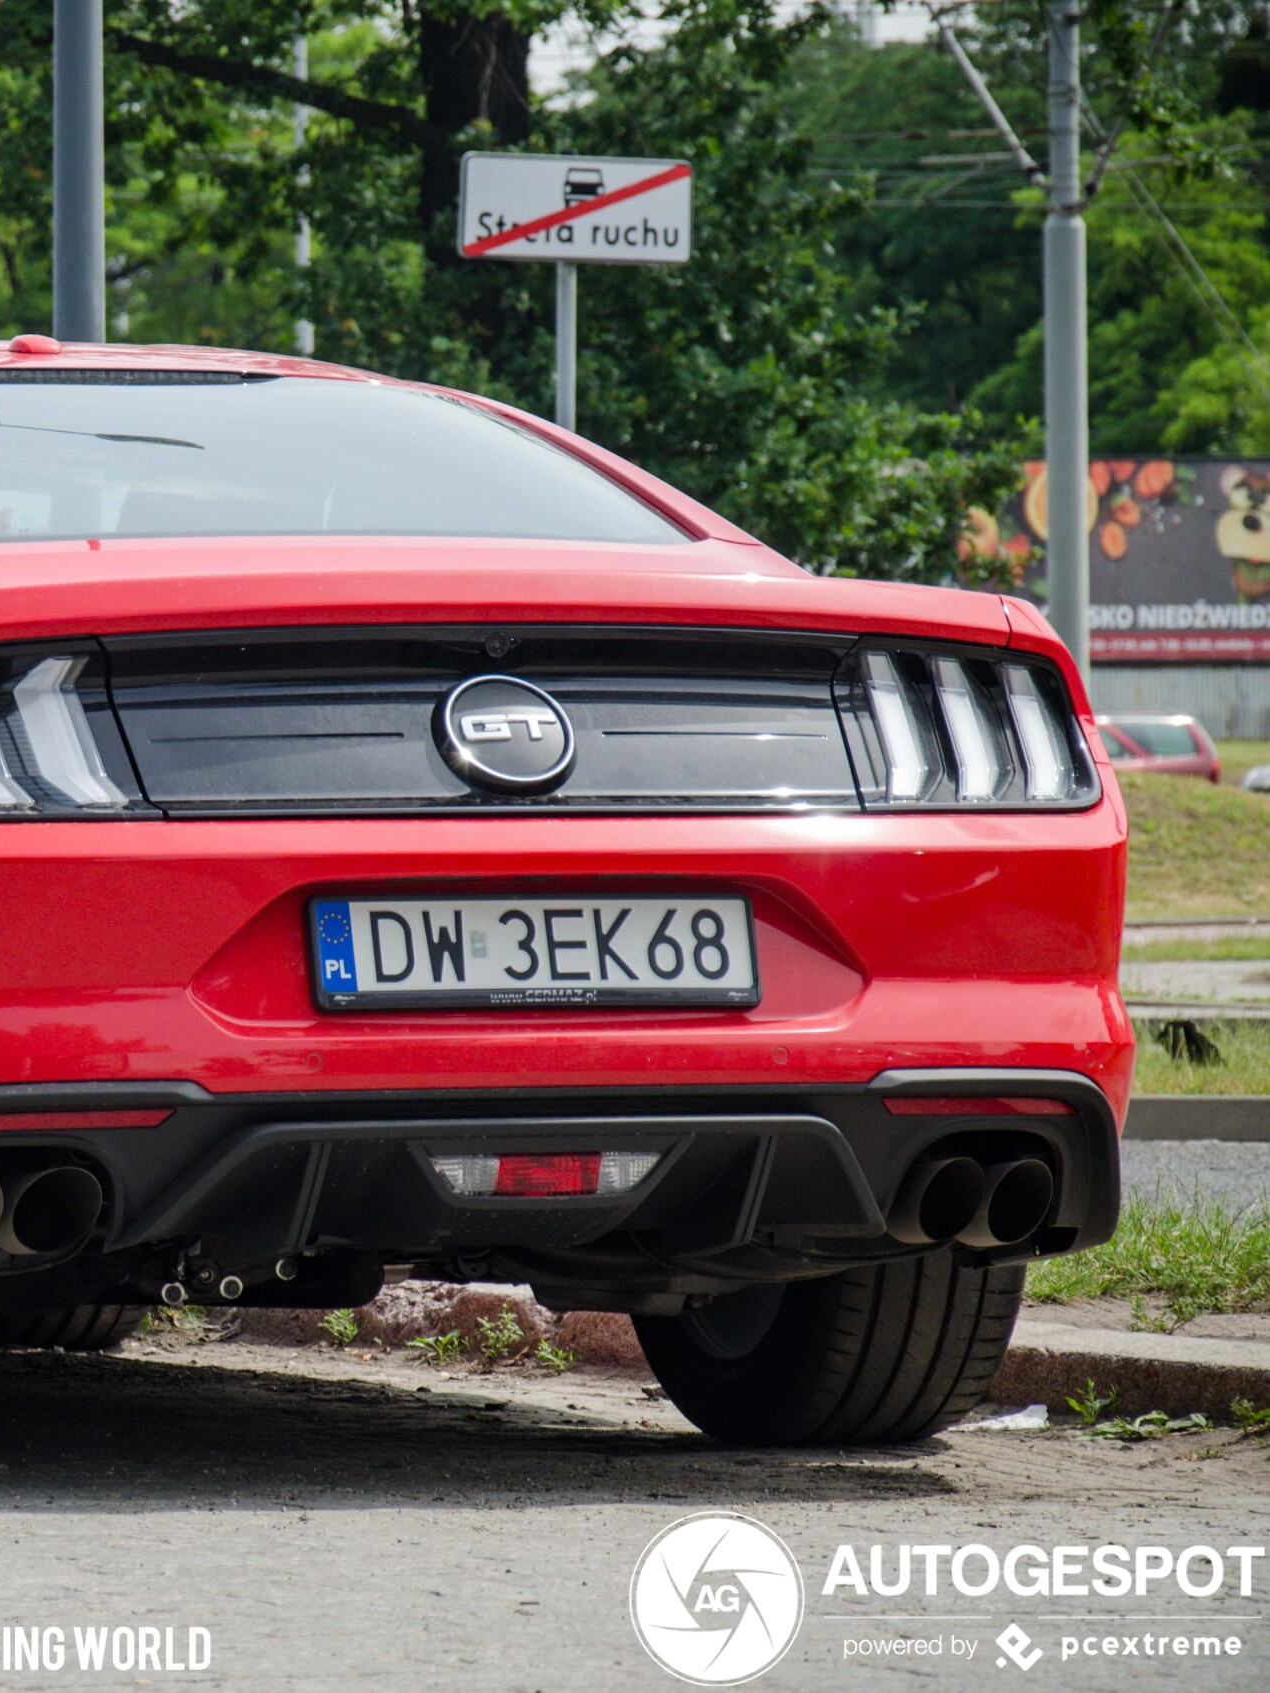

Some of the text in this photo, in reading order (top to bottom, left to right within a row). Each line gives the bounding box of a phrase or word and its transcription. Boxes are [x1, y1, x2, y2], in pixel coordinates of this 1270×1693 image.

[591, 216, 679, 247] ruchu
[1089, 603, 1135, 630] SKO
[461, 713, 557, 742] GT
[369, 908, 730, 983] DW 3EK68
[324, 959, 352, 979] PL
